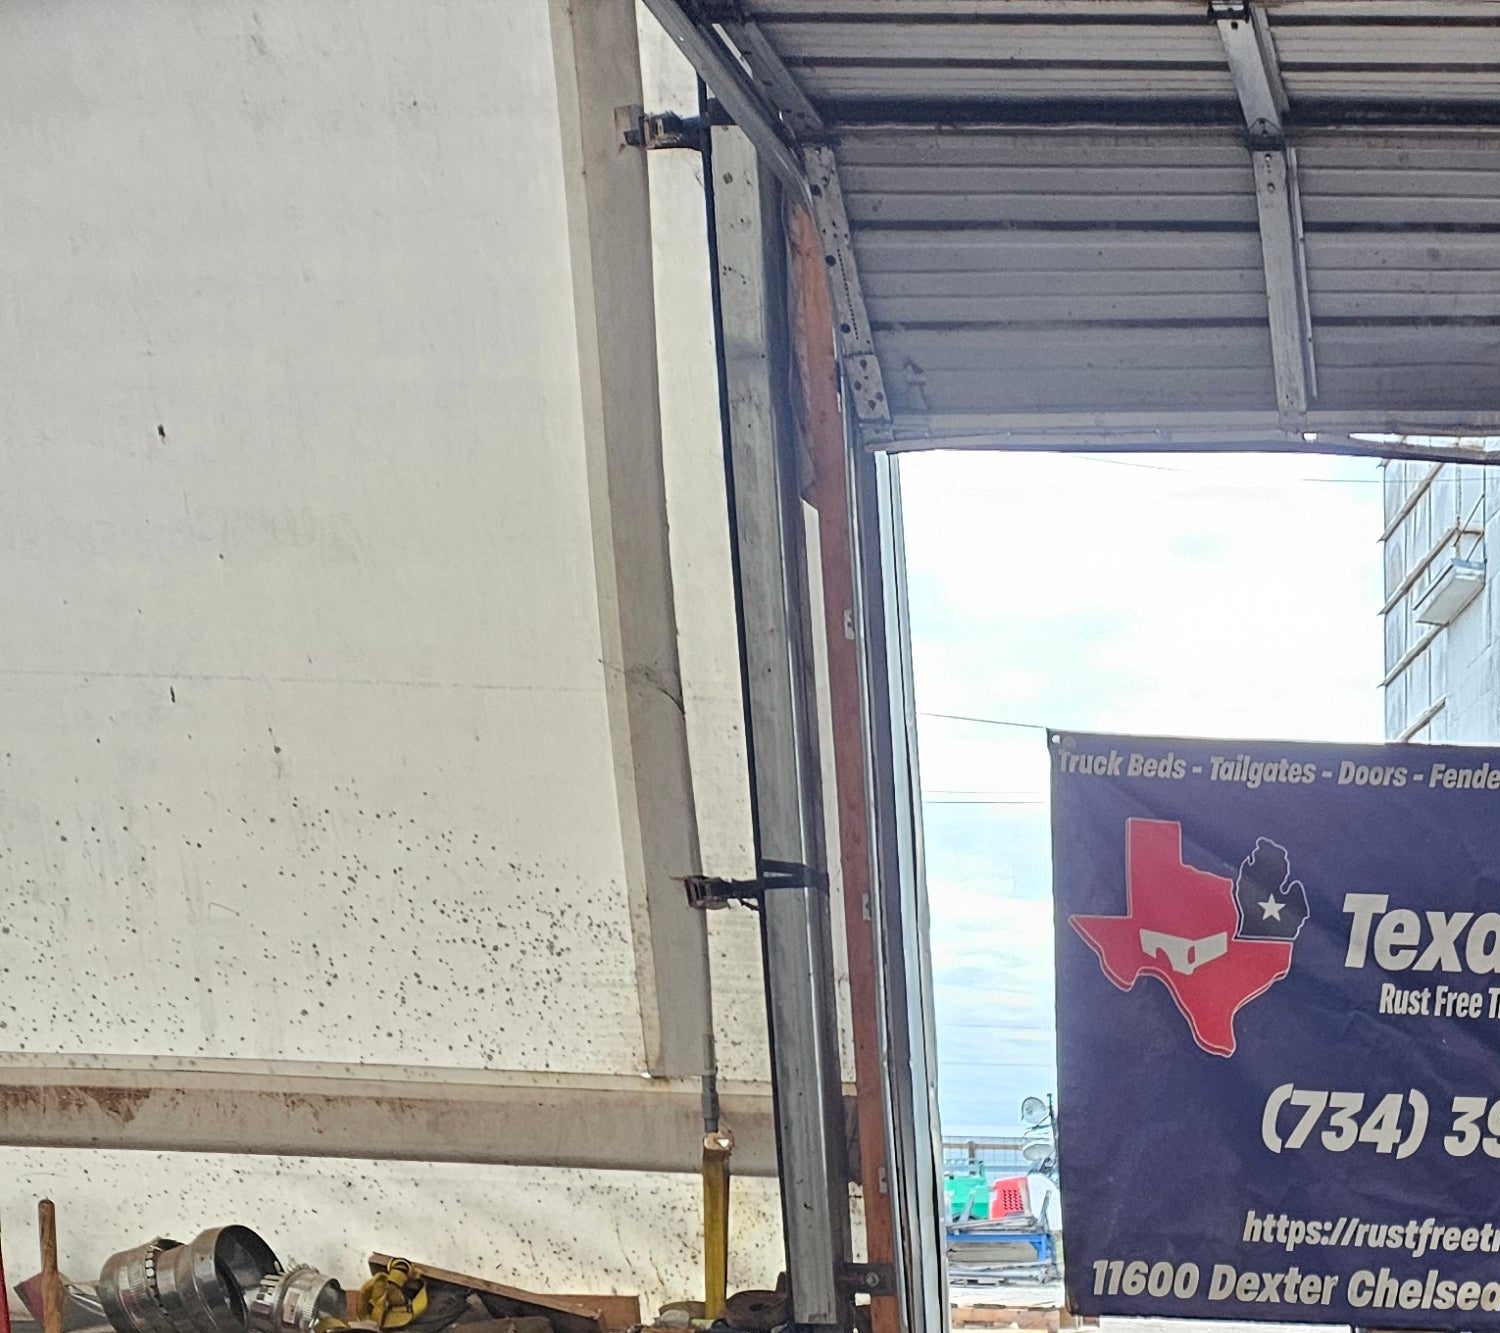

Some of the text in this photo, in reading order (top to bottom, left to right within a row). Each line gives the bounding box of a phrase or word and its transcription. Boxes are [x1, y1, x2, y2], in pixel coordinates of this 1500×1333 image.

[1058, 749, 1121, 776] Truck
[1127, 753, 1187, 780] Beds
[1210, 754, 1317, 789] Tailgates
[1338, 760, 1408, 788] Doors
[1379, 983, 1431, 1017] Rust
[1434, 985, 1483, 1019] Free
[1262, 1083, 1430, 1160] (734)
[1092, 1259, 1201, 1301] 11600
[1207, 1263, 1340, 1307] Dexter
